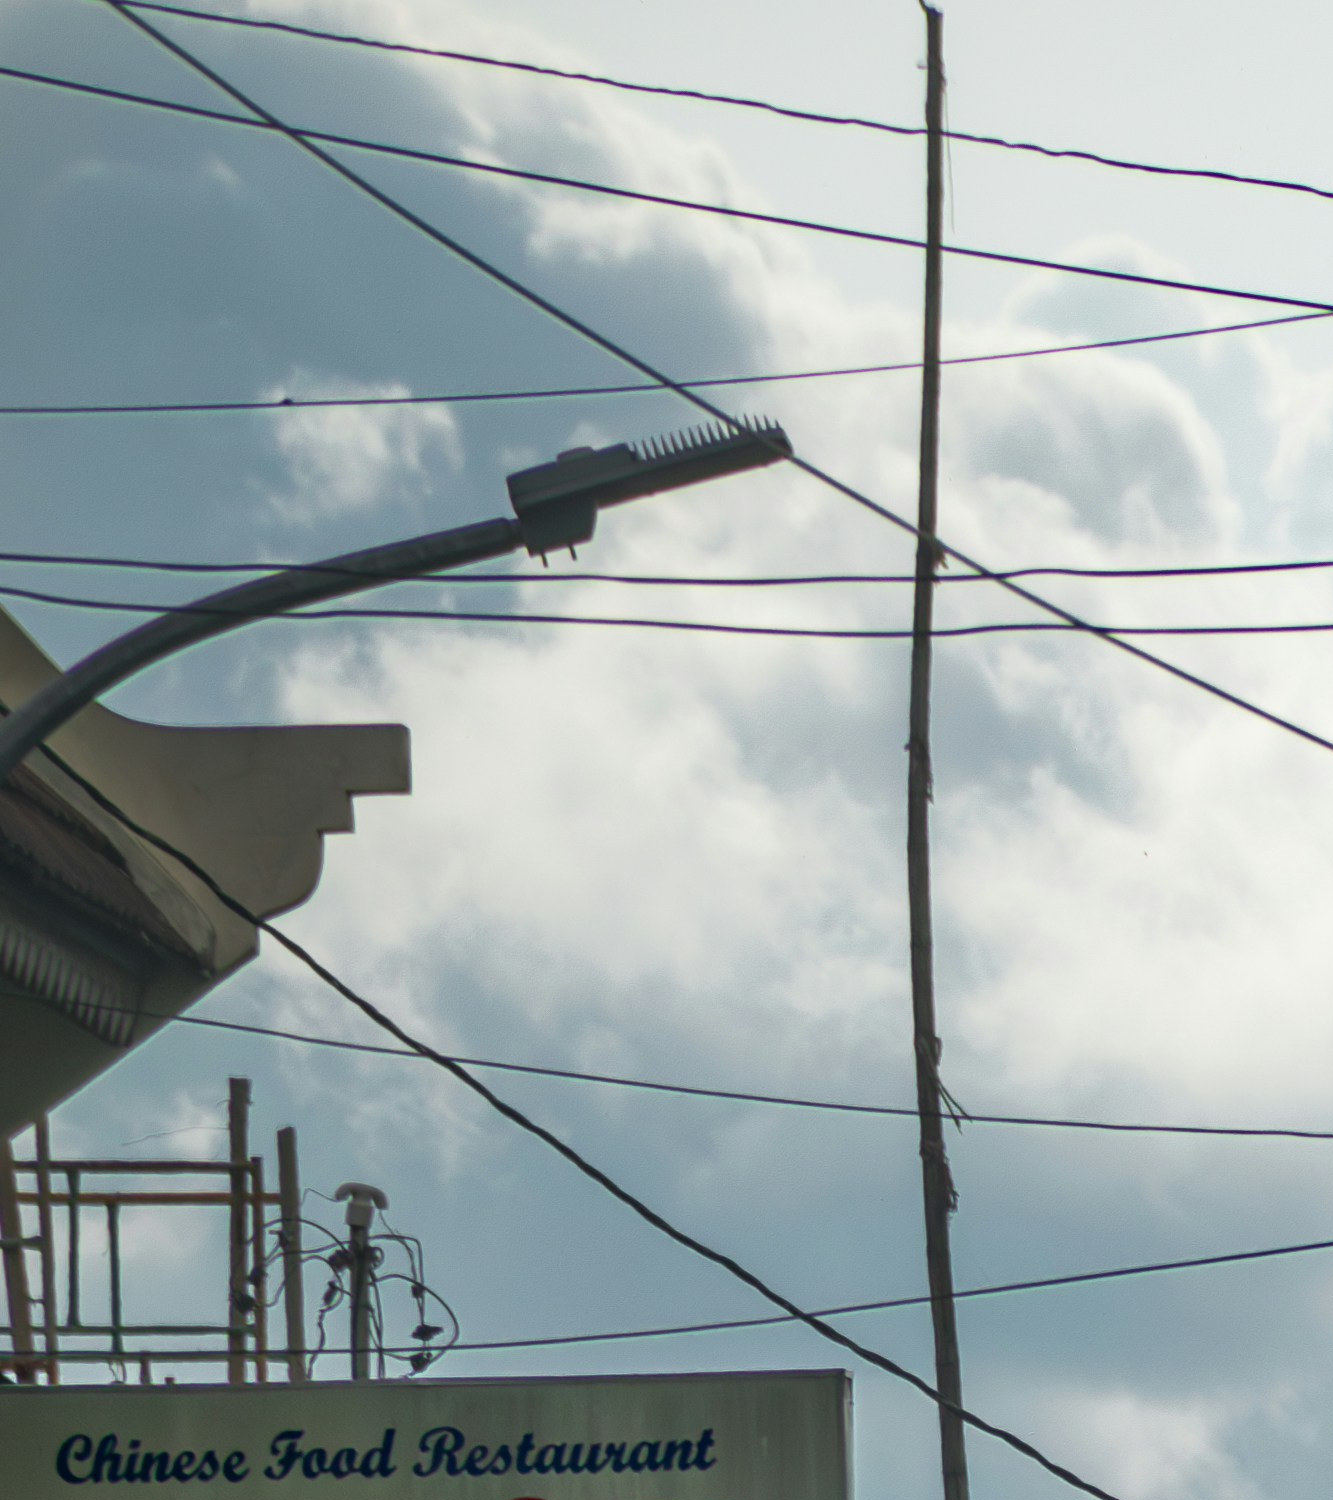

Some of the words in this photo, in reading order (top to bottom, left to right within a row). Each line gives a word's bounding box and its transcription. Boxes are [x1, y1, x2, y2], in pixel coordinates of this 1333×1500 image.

[56, 1433, 250, 1484] Chinese
[265, 1428, 397, 1480] Food
[413, 1426, 717, 1478] Restaurant
